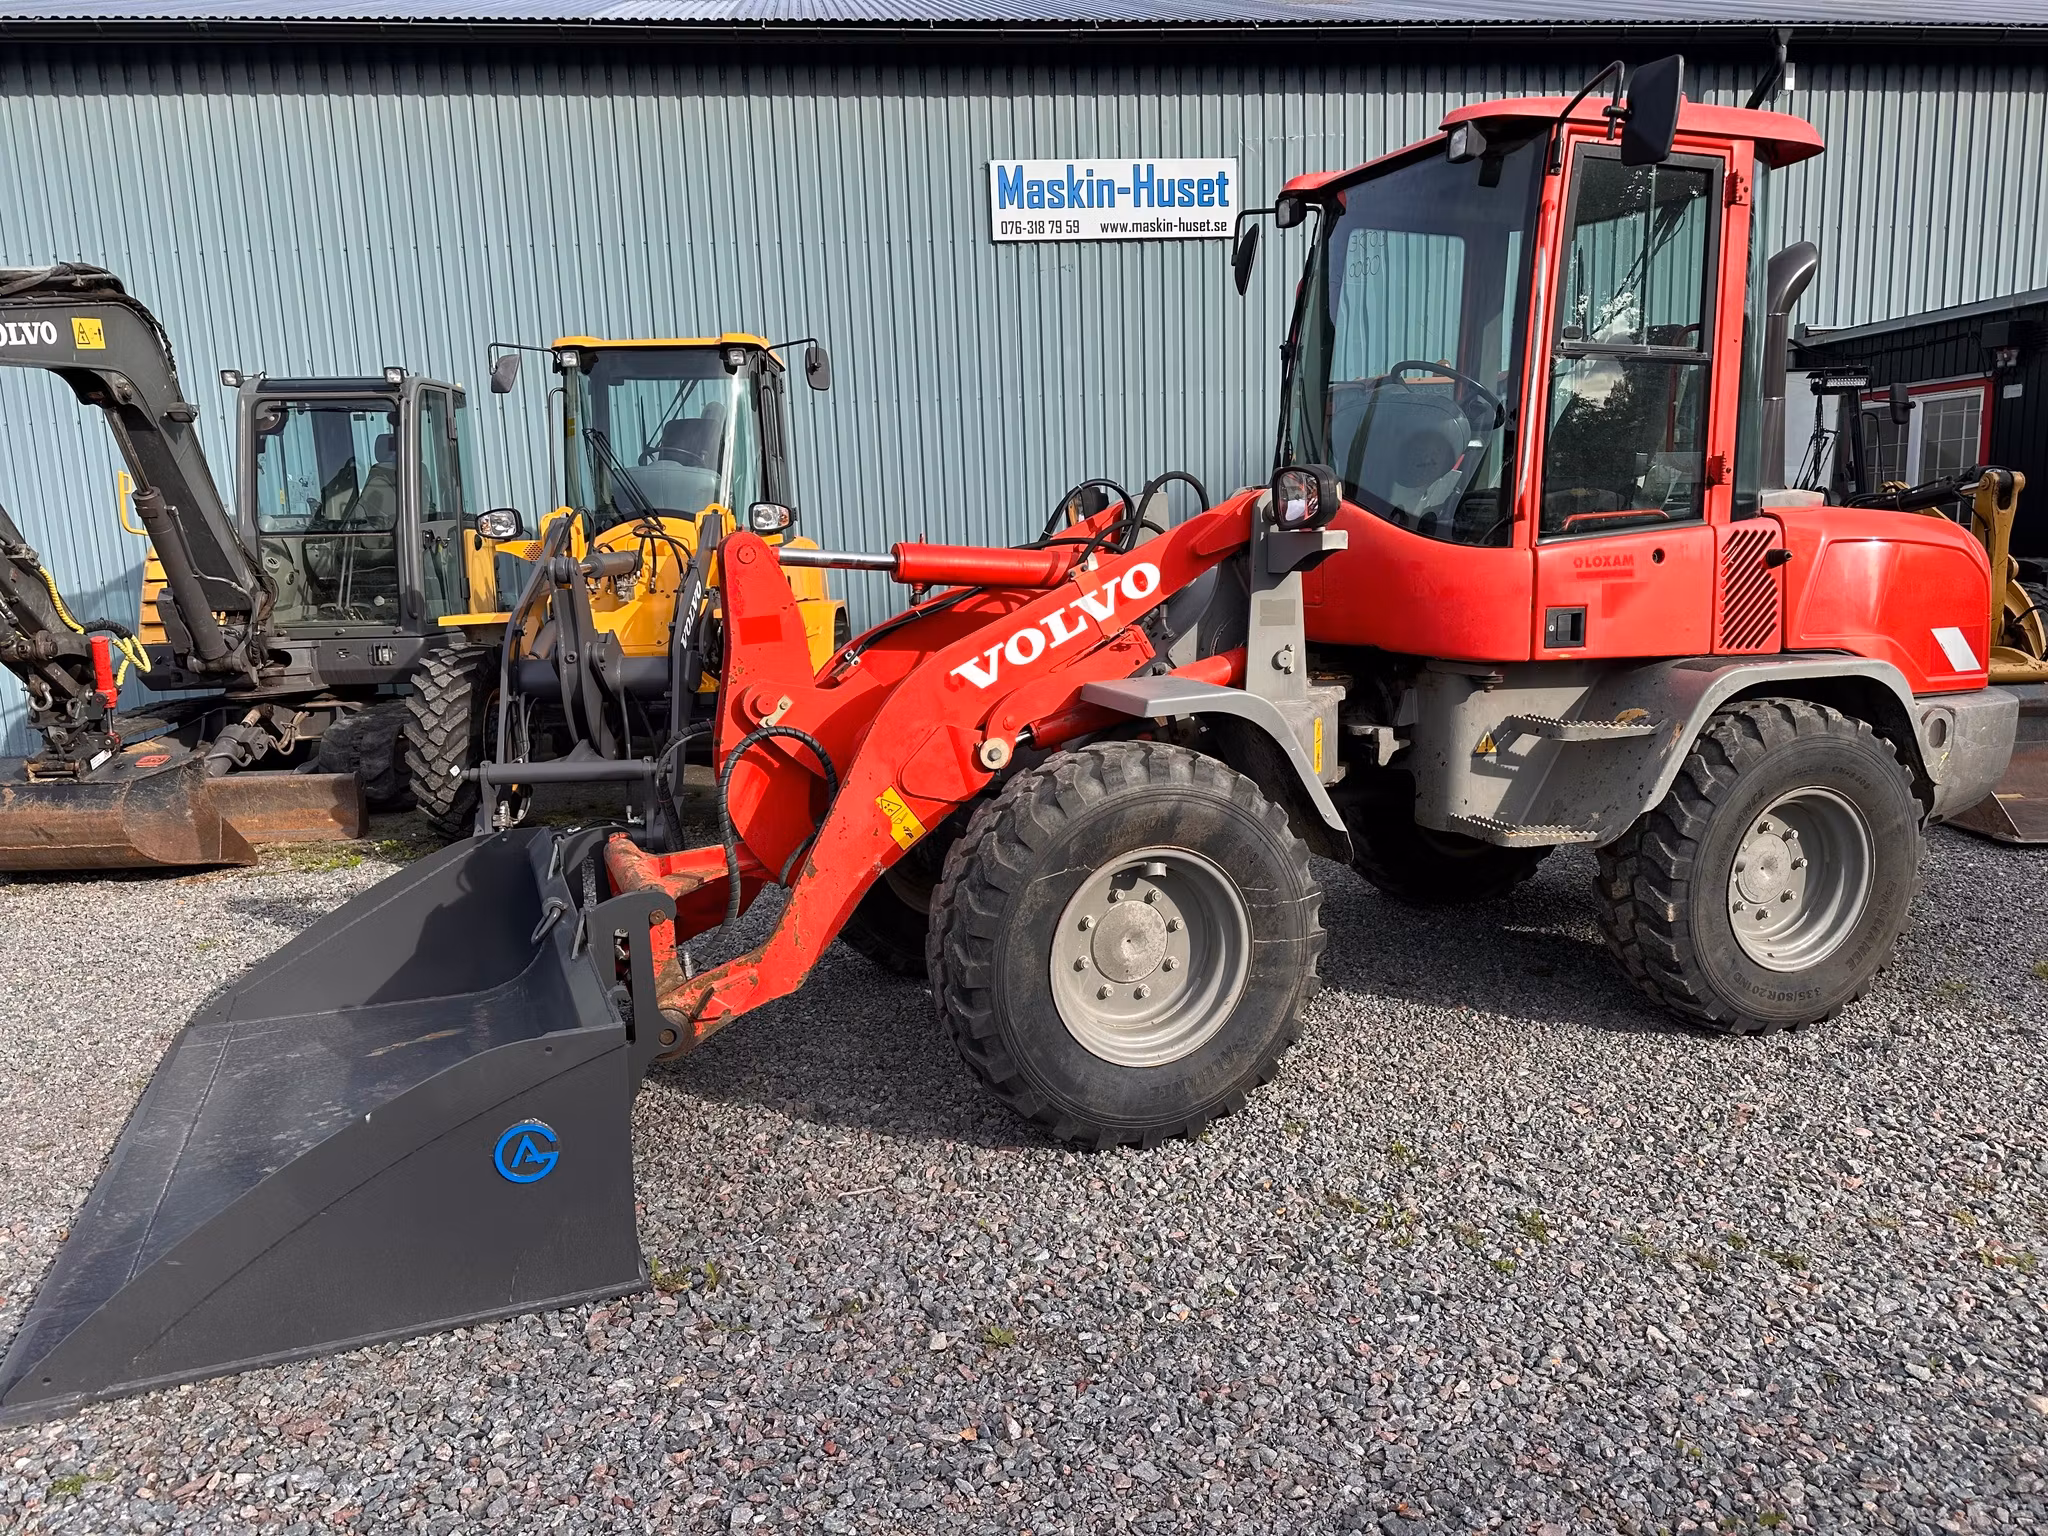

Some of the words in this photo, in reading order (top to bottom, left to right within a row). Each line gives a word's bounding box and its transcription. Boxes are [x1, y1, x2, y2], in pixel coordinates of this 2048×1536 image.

[997, 163, 1229, 210] Maskin-Huset
[1000, 220, 1045, 235] 076-318
[1048, 220, 1063, 235] 79
[1065, 219, 1080, 234] 59
[1099, 217, 1228, 234] www.maskin-huset.se
[680, 580, 702, 649] VOLVO
[949, 561, 1162, 690] VOLVO
